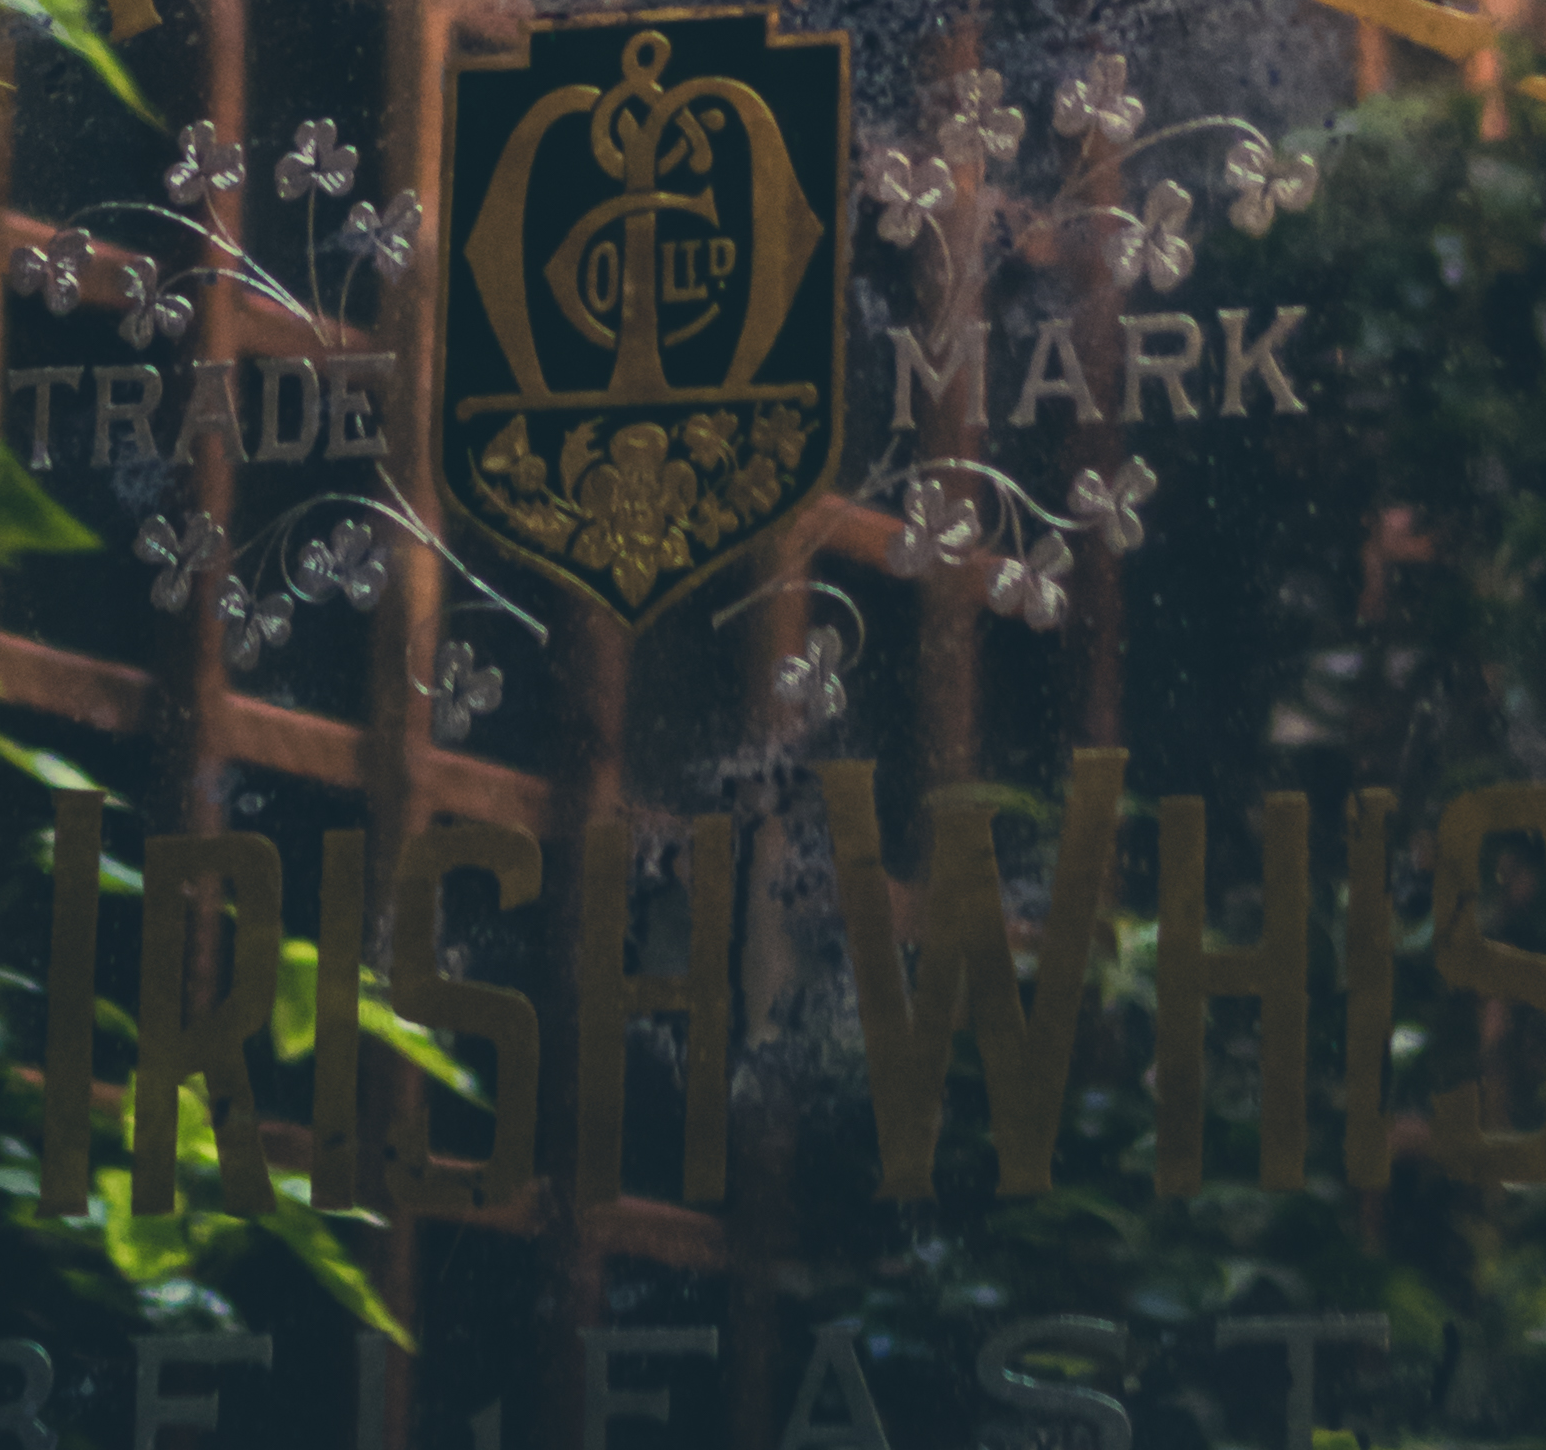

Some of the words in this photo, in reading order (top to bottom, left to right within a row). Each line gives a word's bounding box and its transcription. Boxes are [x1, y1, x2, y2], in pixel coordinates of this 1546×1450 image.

[8, 353, 397, 469] TRADE
[888, 306, 1309, 430] MARK
[42, 788, 733, 1220] IRISH
